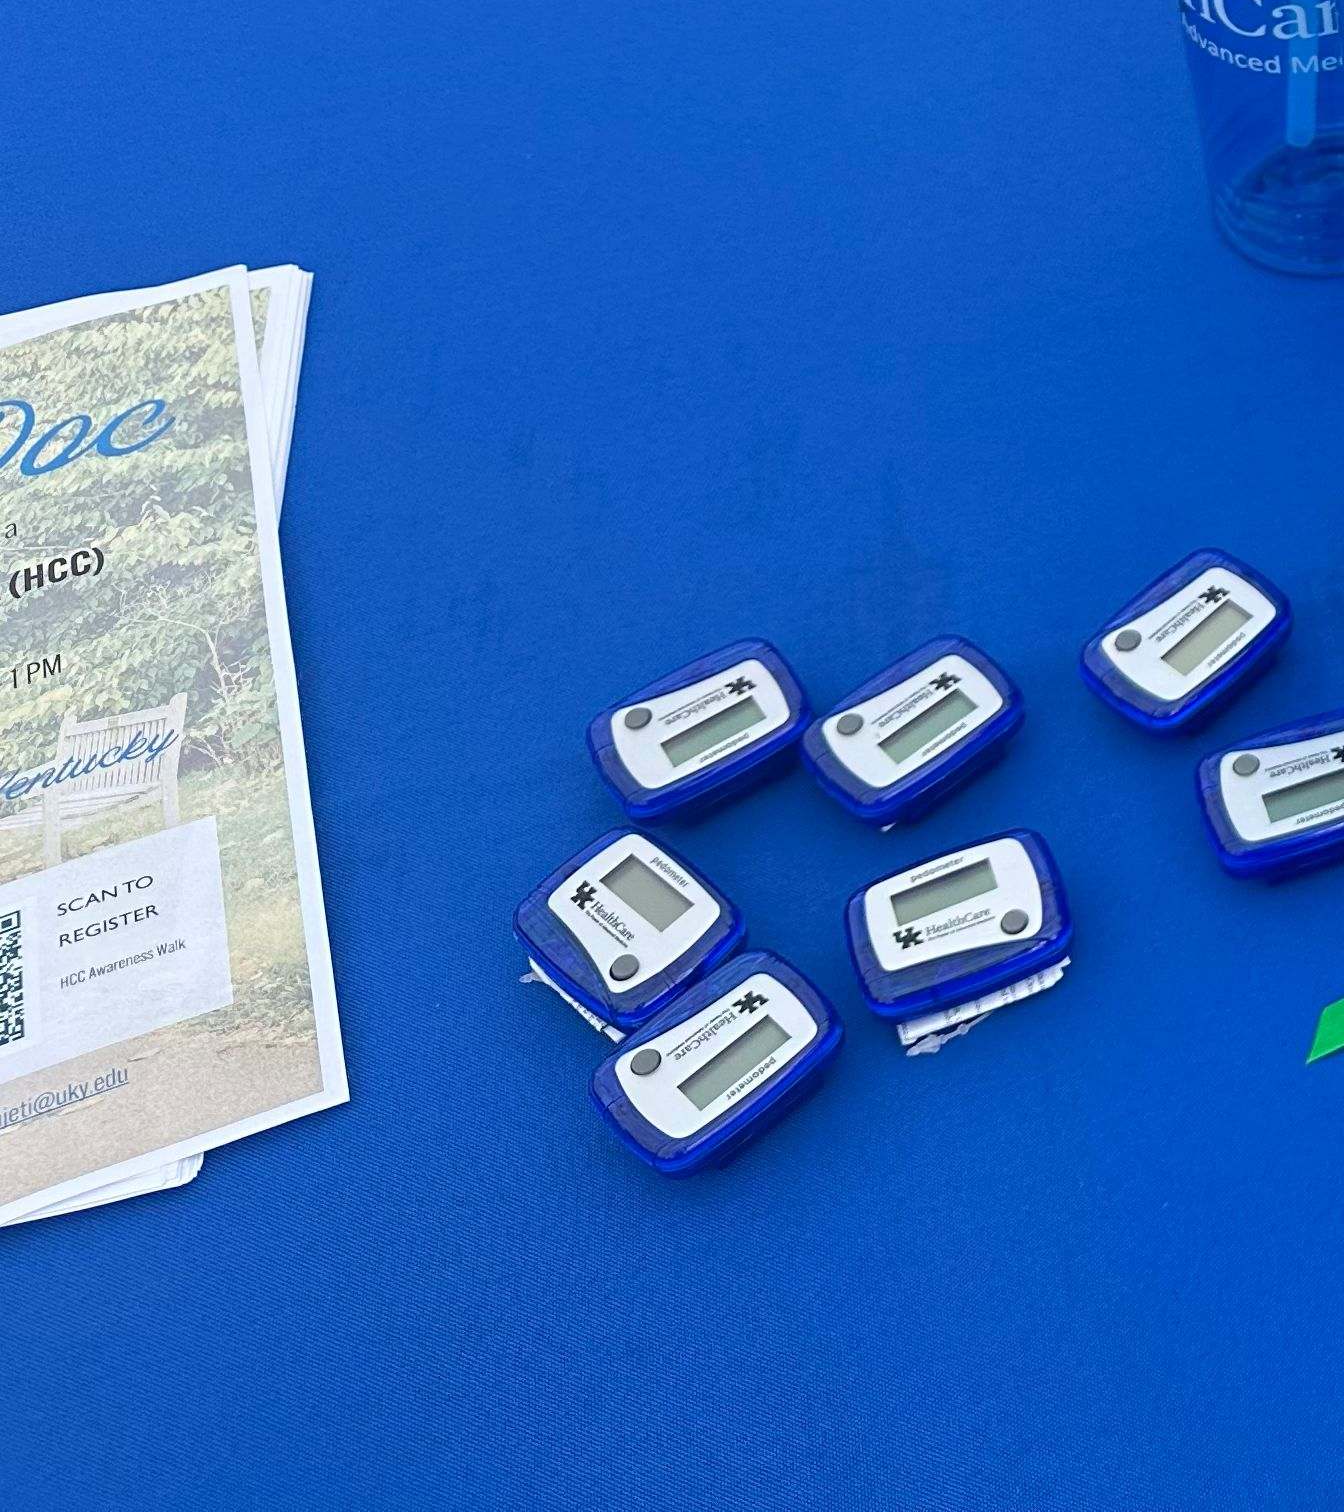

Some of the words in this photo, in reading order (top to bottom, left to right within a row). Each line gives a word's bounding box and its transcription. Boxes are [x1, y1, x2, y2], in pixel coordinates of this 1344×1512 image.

[4, 522, 18, 539] a
[8, 546, 105, 600] (HCC)
[9, 668, 18, 689] 1
[26, 653, 63, 685] PM
[57, 885, 119, 917] SCAN
[121, 875, 155, 894] TO
[58, 904, 160, 948] REGISTER
[591, 900, 636, 942] HealthCare
[60, 969, 87, 989] HCC
[88, 948, 155, 981] Awareness
[155, 938, 187, 957] Walk
[673, 1009, 738, 1062] HealthCare
[724, 1055, 778, 1101] pedometer
